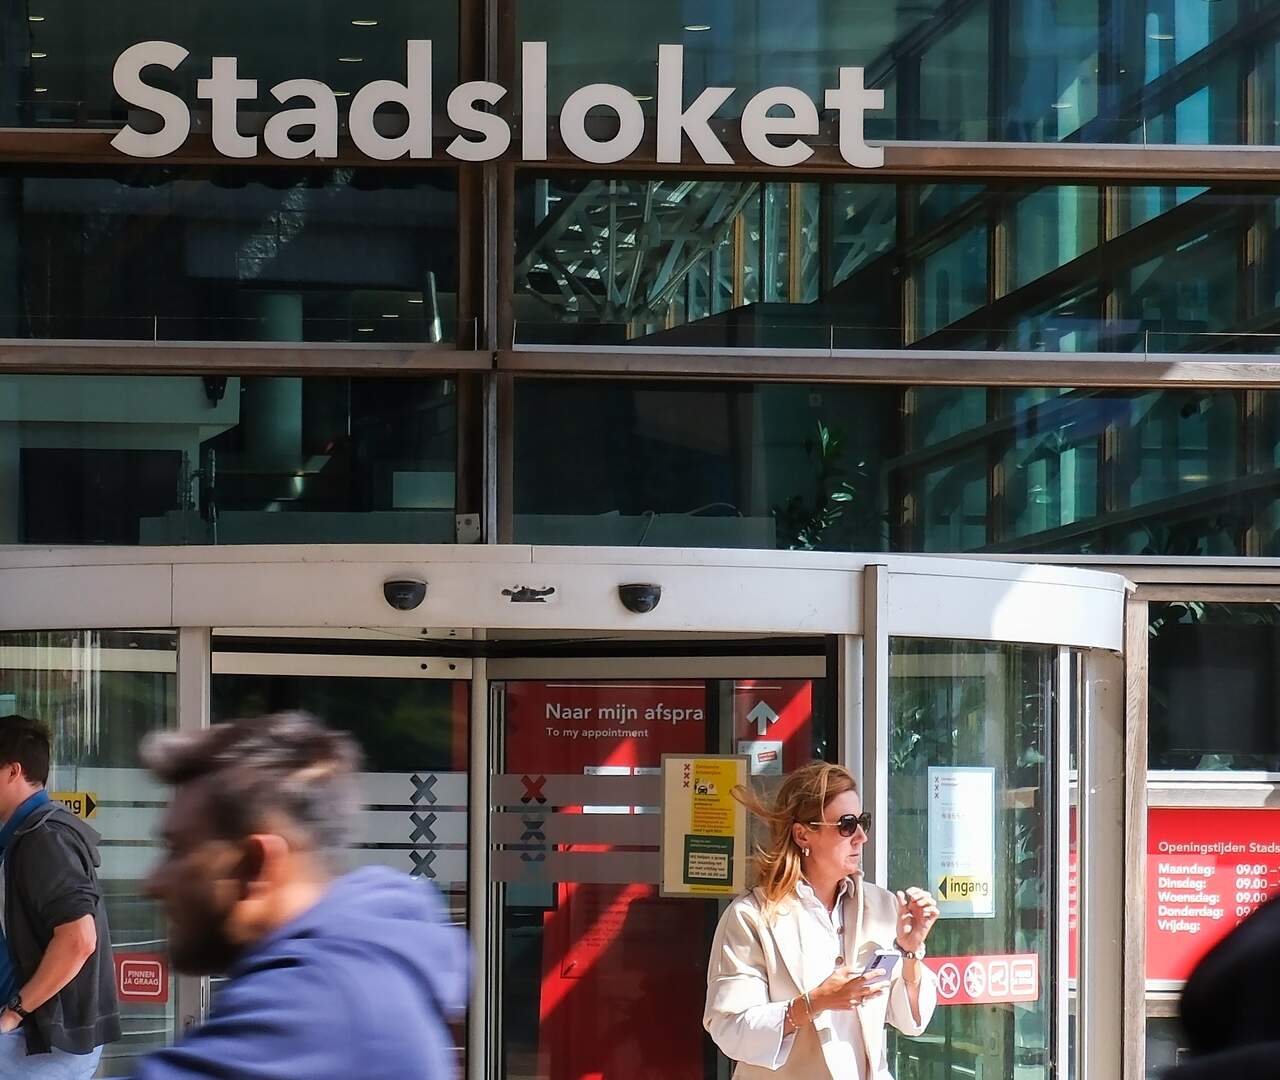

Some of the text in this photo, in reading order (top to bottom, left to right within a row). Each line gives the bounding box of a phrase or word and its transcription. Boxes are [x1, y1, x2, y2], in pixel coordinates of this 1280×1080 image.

[110, 39, 885, 168] Stadsloket
[545, 703, 704, 724] Naar mijn afspra
[546, 727, 649, 740] To my appointment
[1158, 841, 1246, 855] Openingstijden
[1158, 863, 1216, 877] Maandag:
[1236, 864, 1268, 876] 09.00
[950, 877, 989, 897] ingang
[1158, 877, 1207, 891] Dinsdag:
[1236, 878, 1268, 889] 09.00
[1158, 891, 1268, 905] Woensdag: 09.00
[1158, 905, 1224, 919] Donderdag:
[1158, 919, 1201, 934] Vrijdag:
